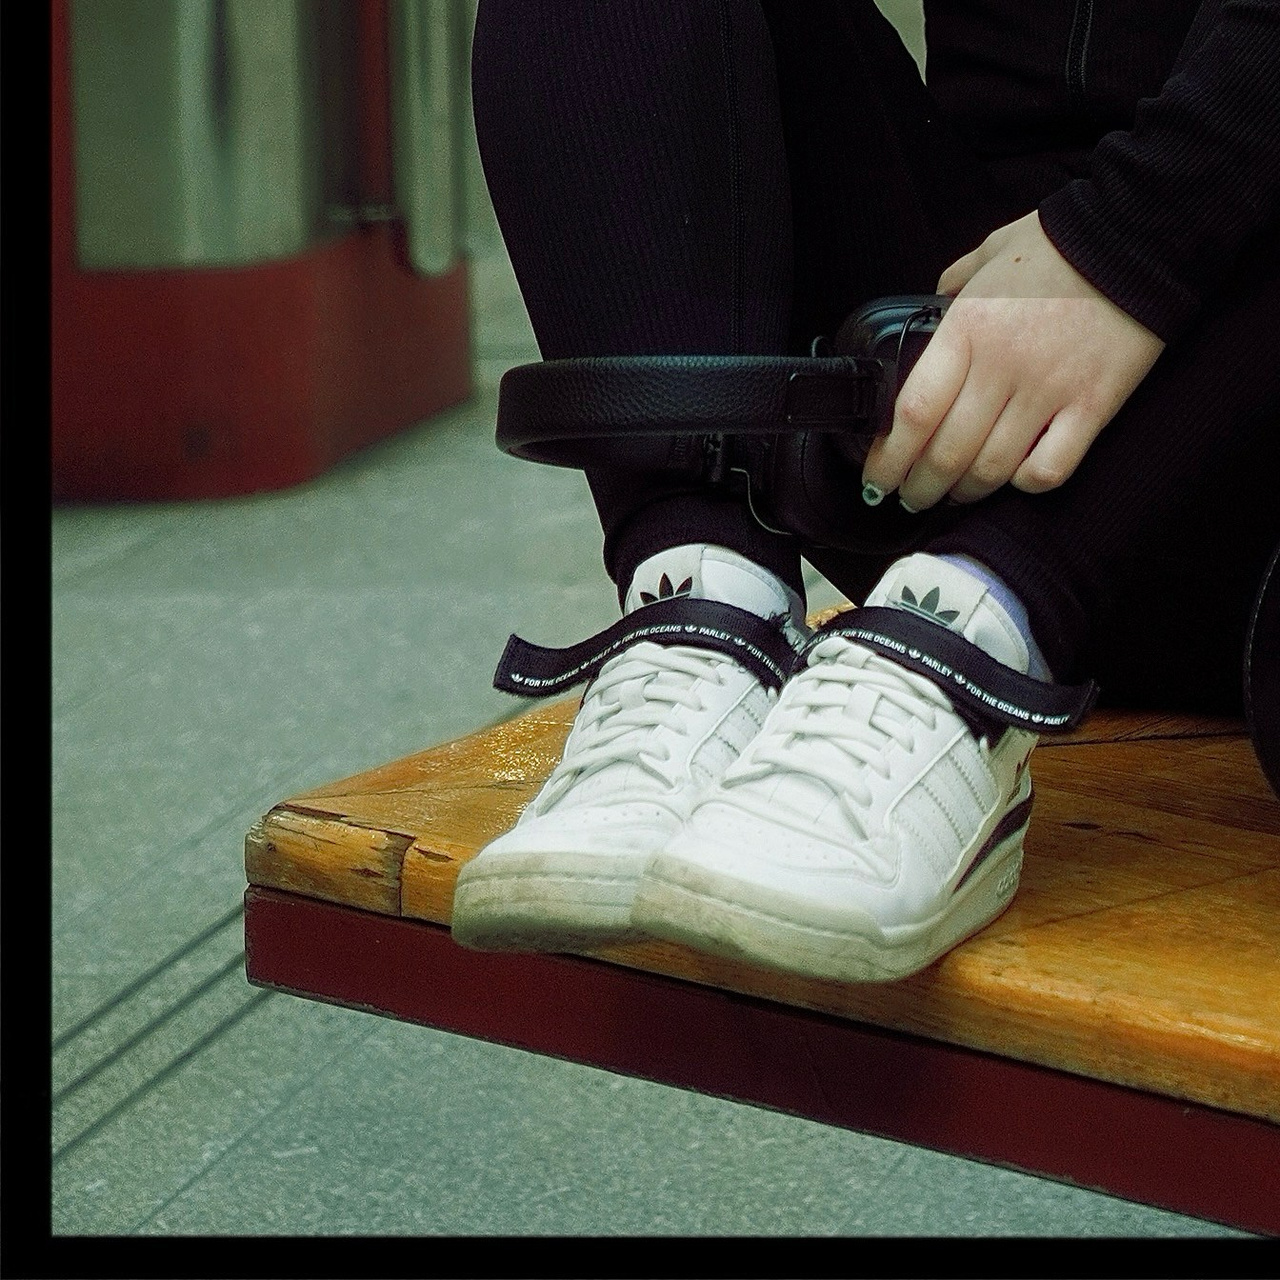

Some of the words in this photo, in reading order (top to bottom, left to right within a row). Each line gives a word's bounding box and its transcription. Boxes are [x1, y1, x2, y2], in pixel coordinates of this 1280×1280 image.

[523, 678, 540, 688] FOR
[635, 628, 648, 638] THE
[649, 625, 682, 635] OCEANS
[698, 626, 732, 642] PARLEY
[746, 644, 763, 661] FOR
[761, 655, 775, 670] THE
[857, 631, 873, 641] THE
[873, 634, 907, 654] OCEANS
[921, 655, 953, 678] PARLEY
[965, 682, 982, 698] FOR
[982, 693, 997, 707] THE
[997, 701, 1030, 721] OCEANS
